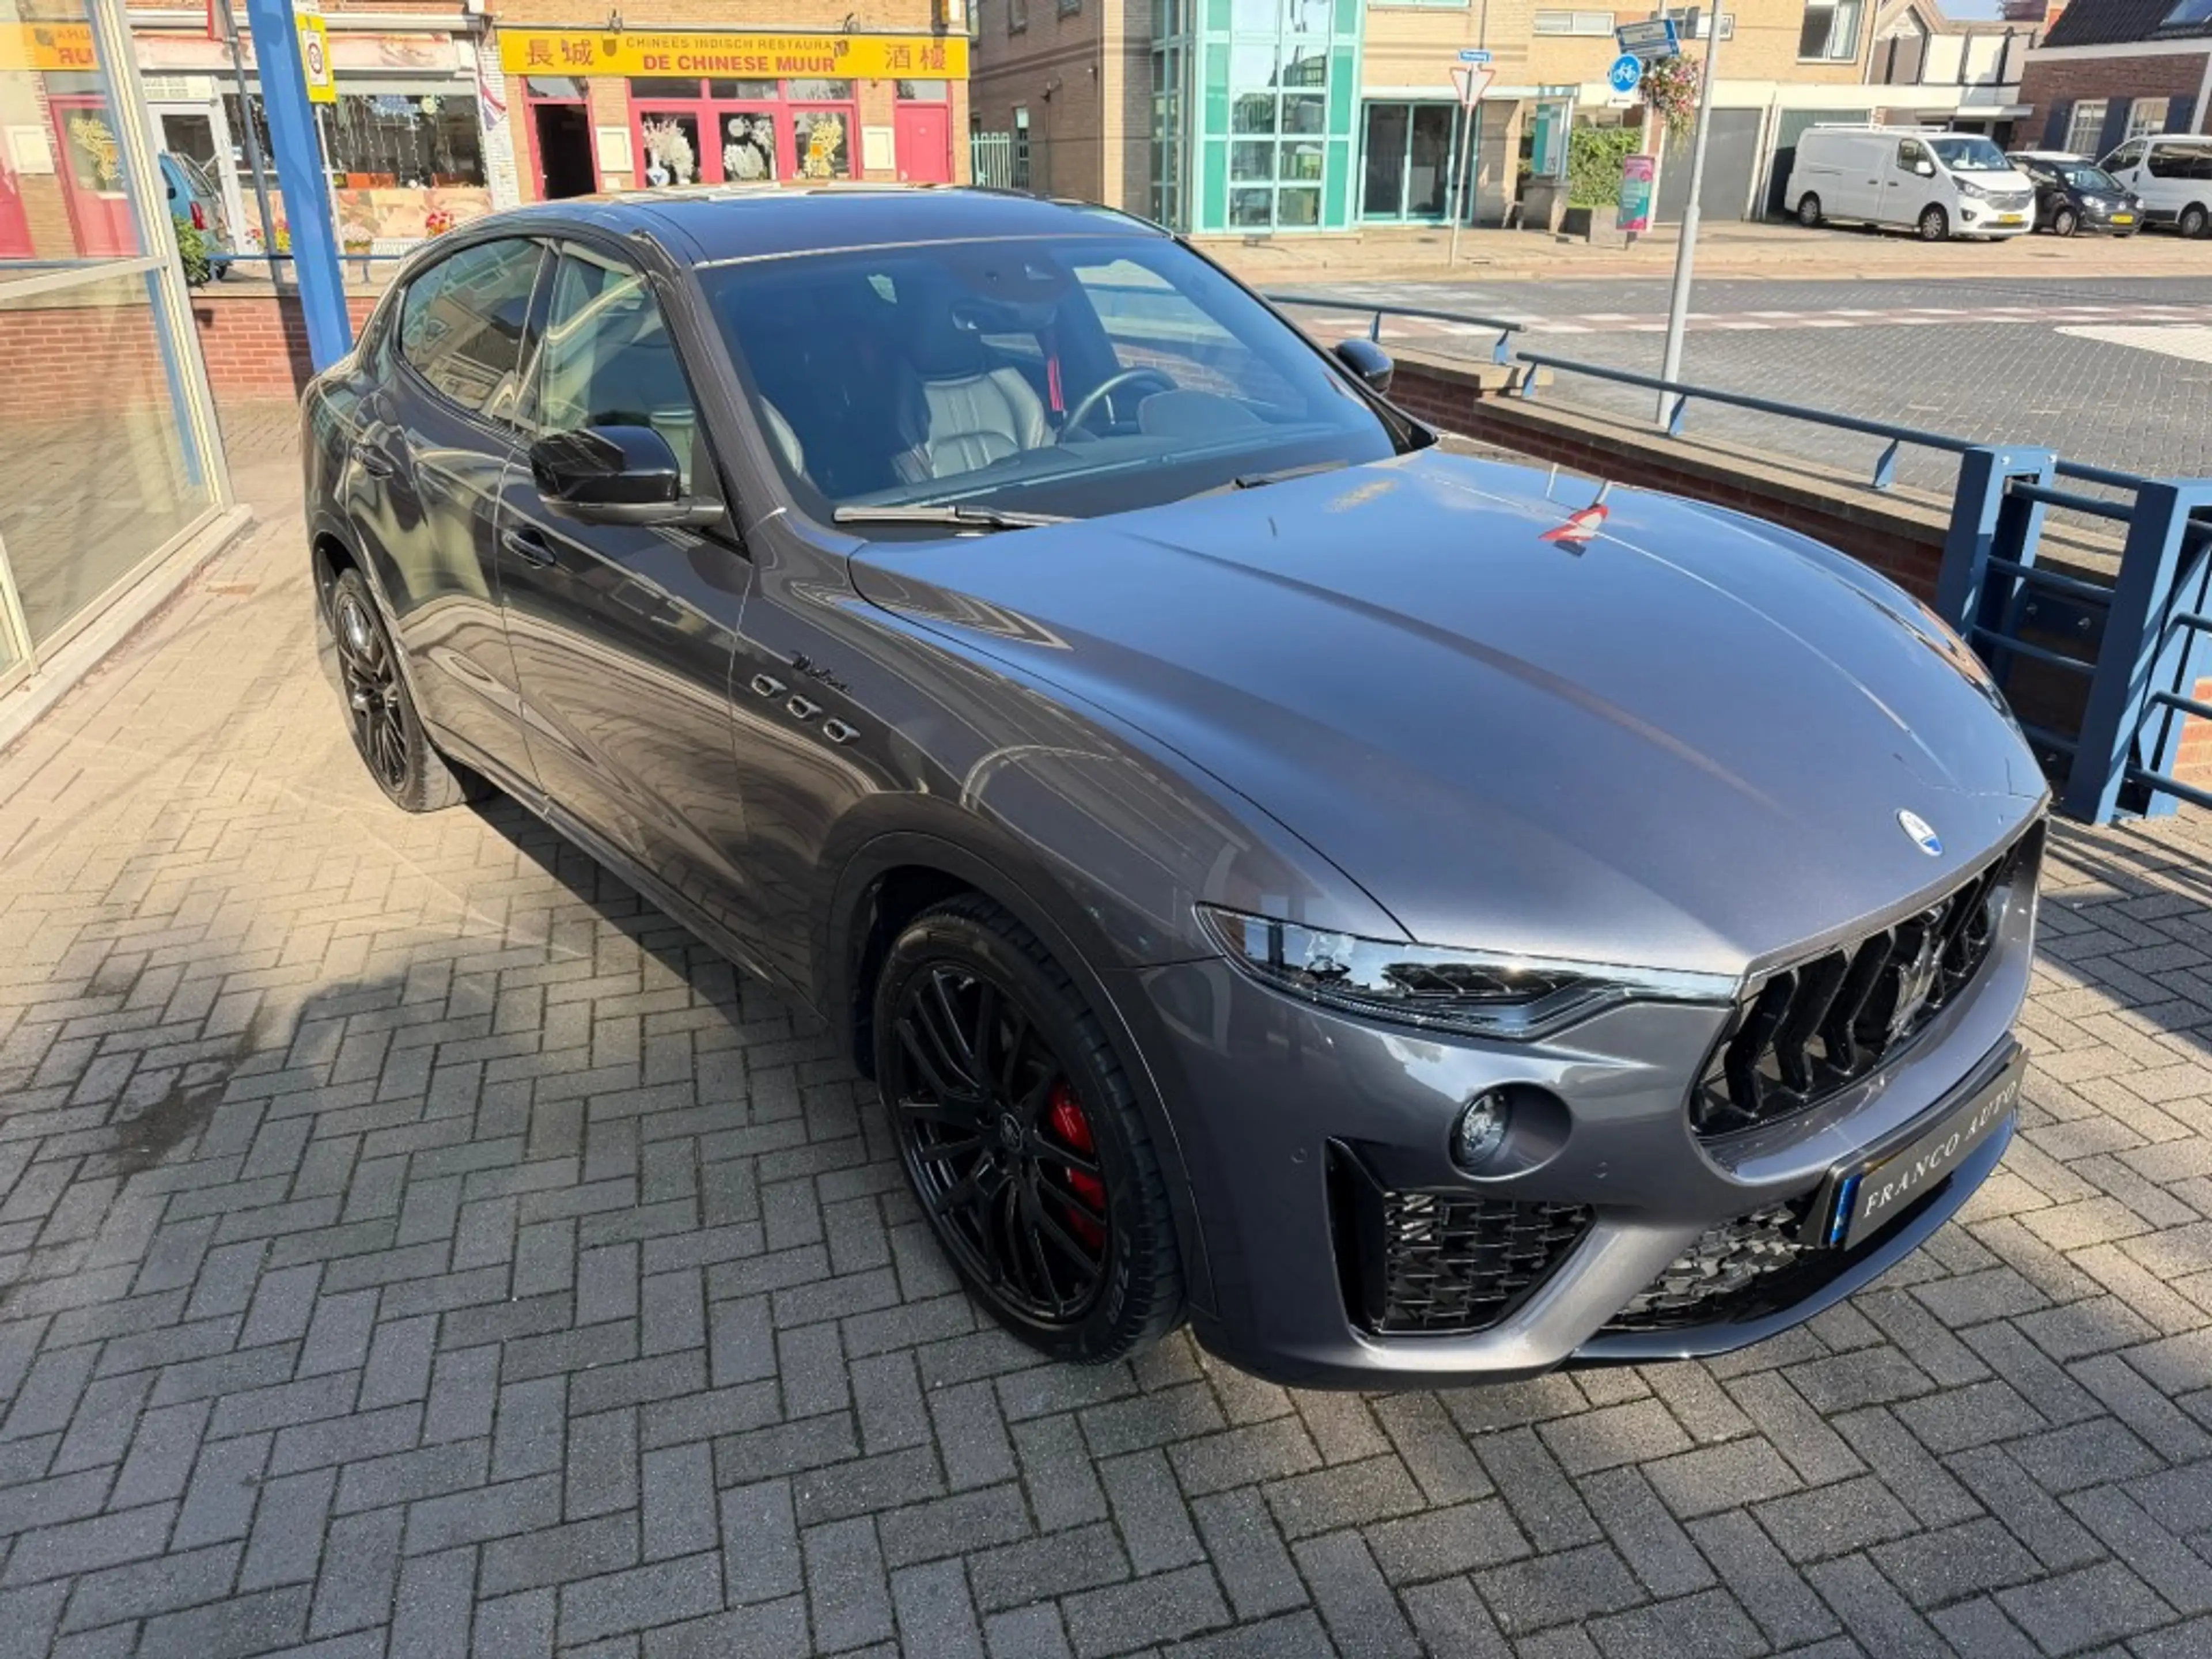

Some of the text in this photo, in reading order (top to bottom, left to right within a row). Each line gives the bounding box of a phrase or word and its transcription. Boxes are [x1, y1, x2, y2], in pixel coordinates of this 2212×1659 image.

[525, 38, 594, 67] 長城
[626, 37, 833, 51] CHINEES INDISCH RESTAURA
[885, 43, 946, 71] 酒樓
[643, 55, 835, 72] DE CHINESE MUUR
[1864, 1080, 2017, 1218] FRANCO AUTO
